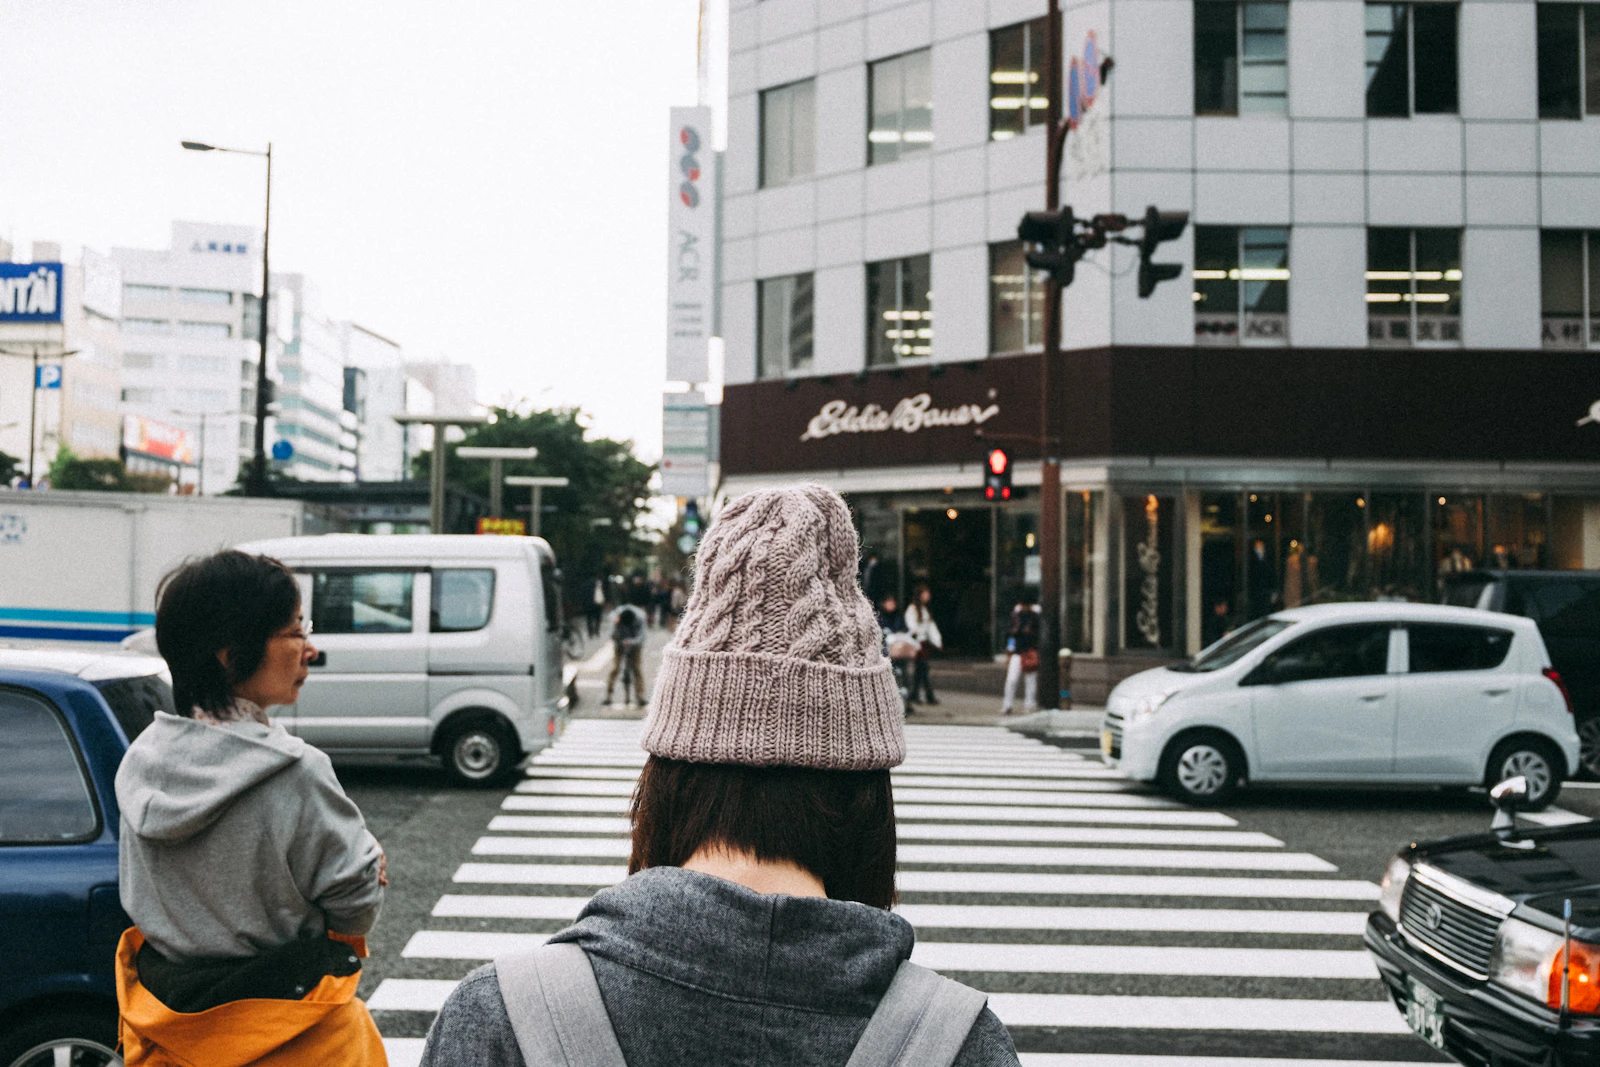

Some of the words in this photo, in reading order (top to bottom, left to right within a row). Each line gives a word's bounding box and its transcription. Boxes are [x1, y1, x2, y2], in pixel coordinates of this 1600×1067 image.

[41, 365, 60, 388] P
[800, 400, 890, 442] Eddie
[891, 393, 999, 433] Bauer
